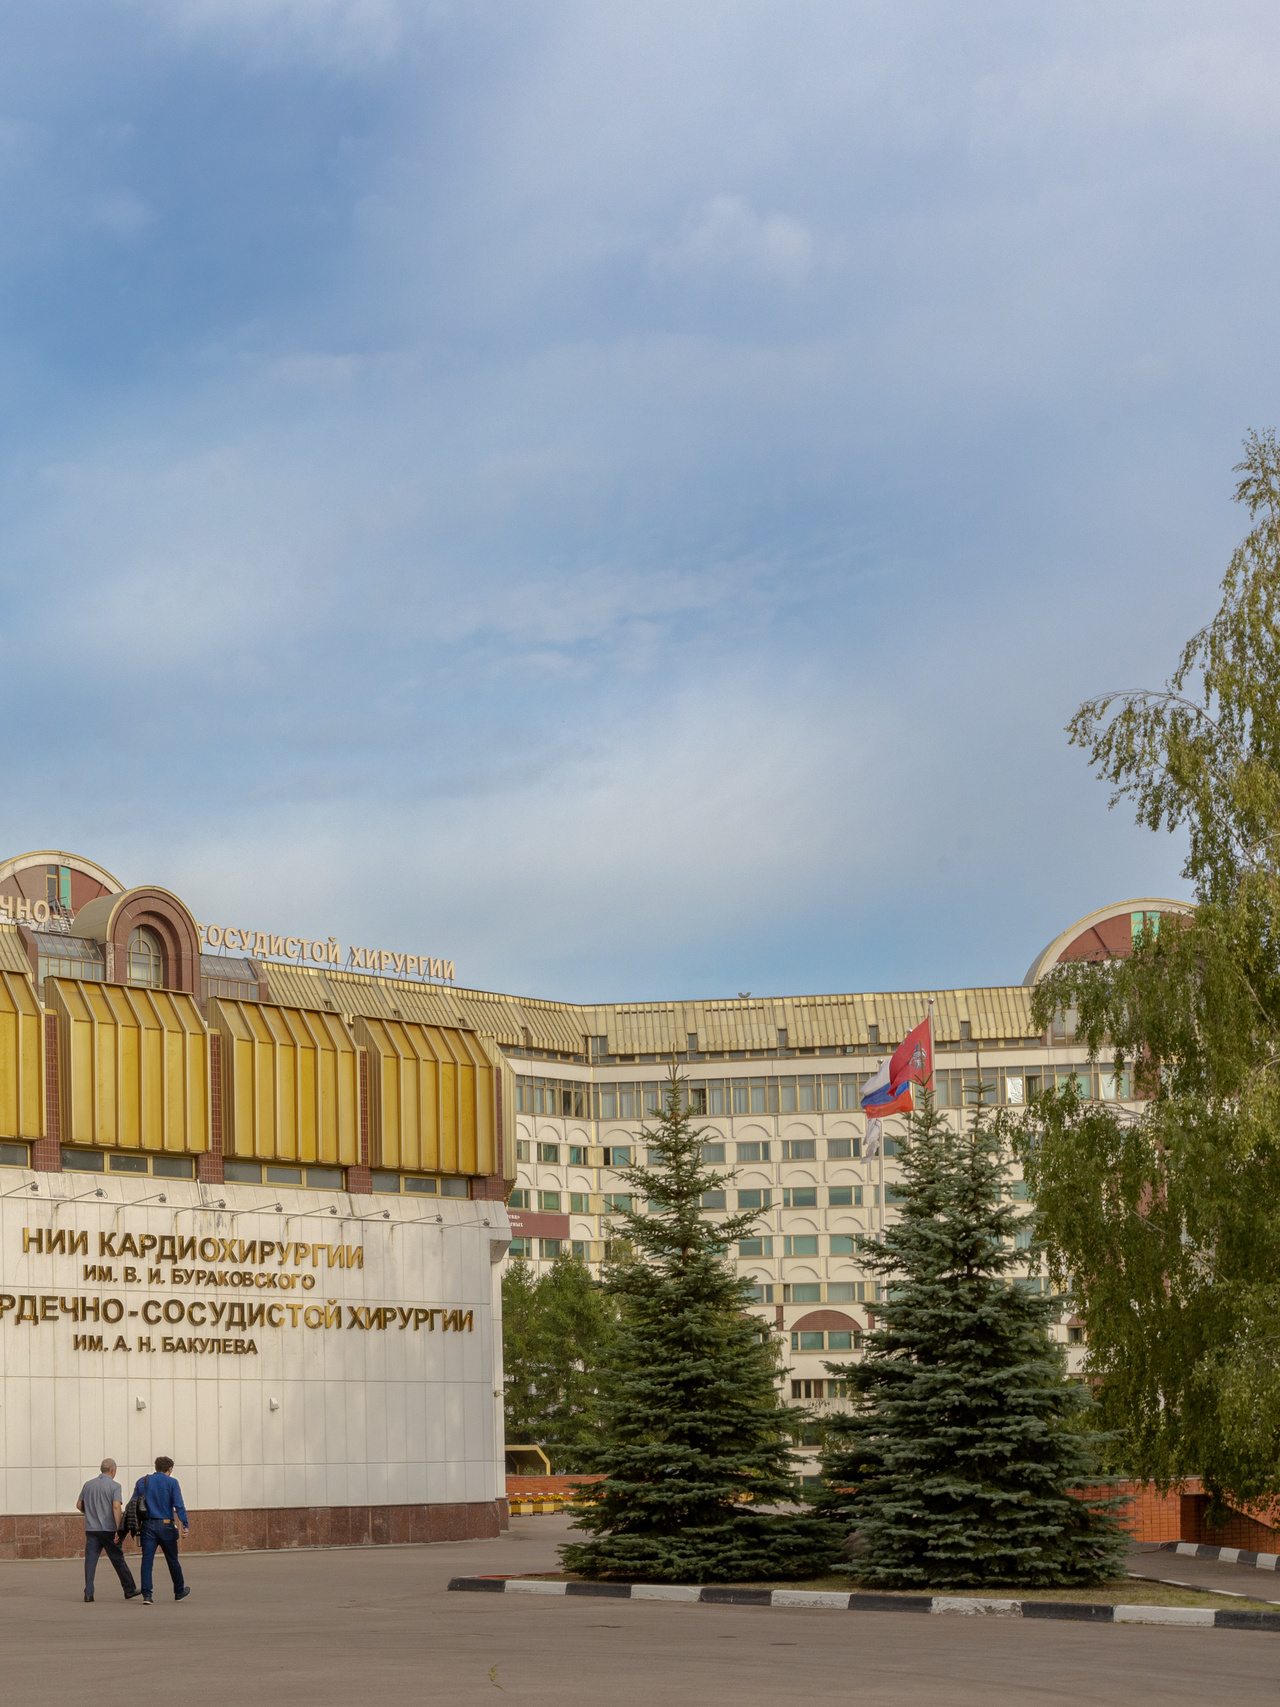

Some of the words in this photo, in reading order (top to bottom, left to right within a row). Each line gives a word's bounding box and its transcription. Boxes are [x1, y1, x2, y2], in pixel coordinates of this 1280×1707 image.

[349, 946, 456, 981] ХИРУРГИИ
[22, 1227, 89, 1256] НИИ
[98, 1231, 364, 1269] КАРДИОХИРУРГИИ
[82, 1264, 119, 1283] ИМ.
[123, 1266, 142, 1284] В.
[147, 1267, 166, 1285] И.
[170, 1268, 316, 1291] БУРАКОВСКОГО
[346, 1305, 474, 1333] ХИРУРГИИ
[72, 1334, 109, 1352] ИМ.
[112, 1335, 132, 1352] А.
[137, 1336, 156, 1353] Н.
[160, 1336, 259, 1355] БАКУЛЕВА
